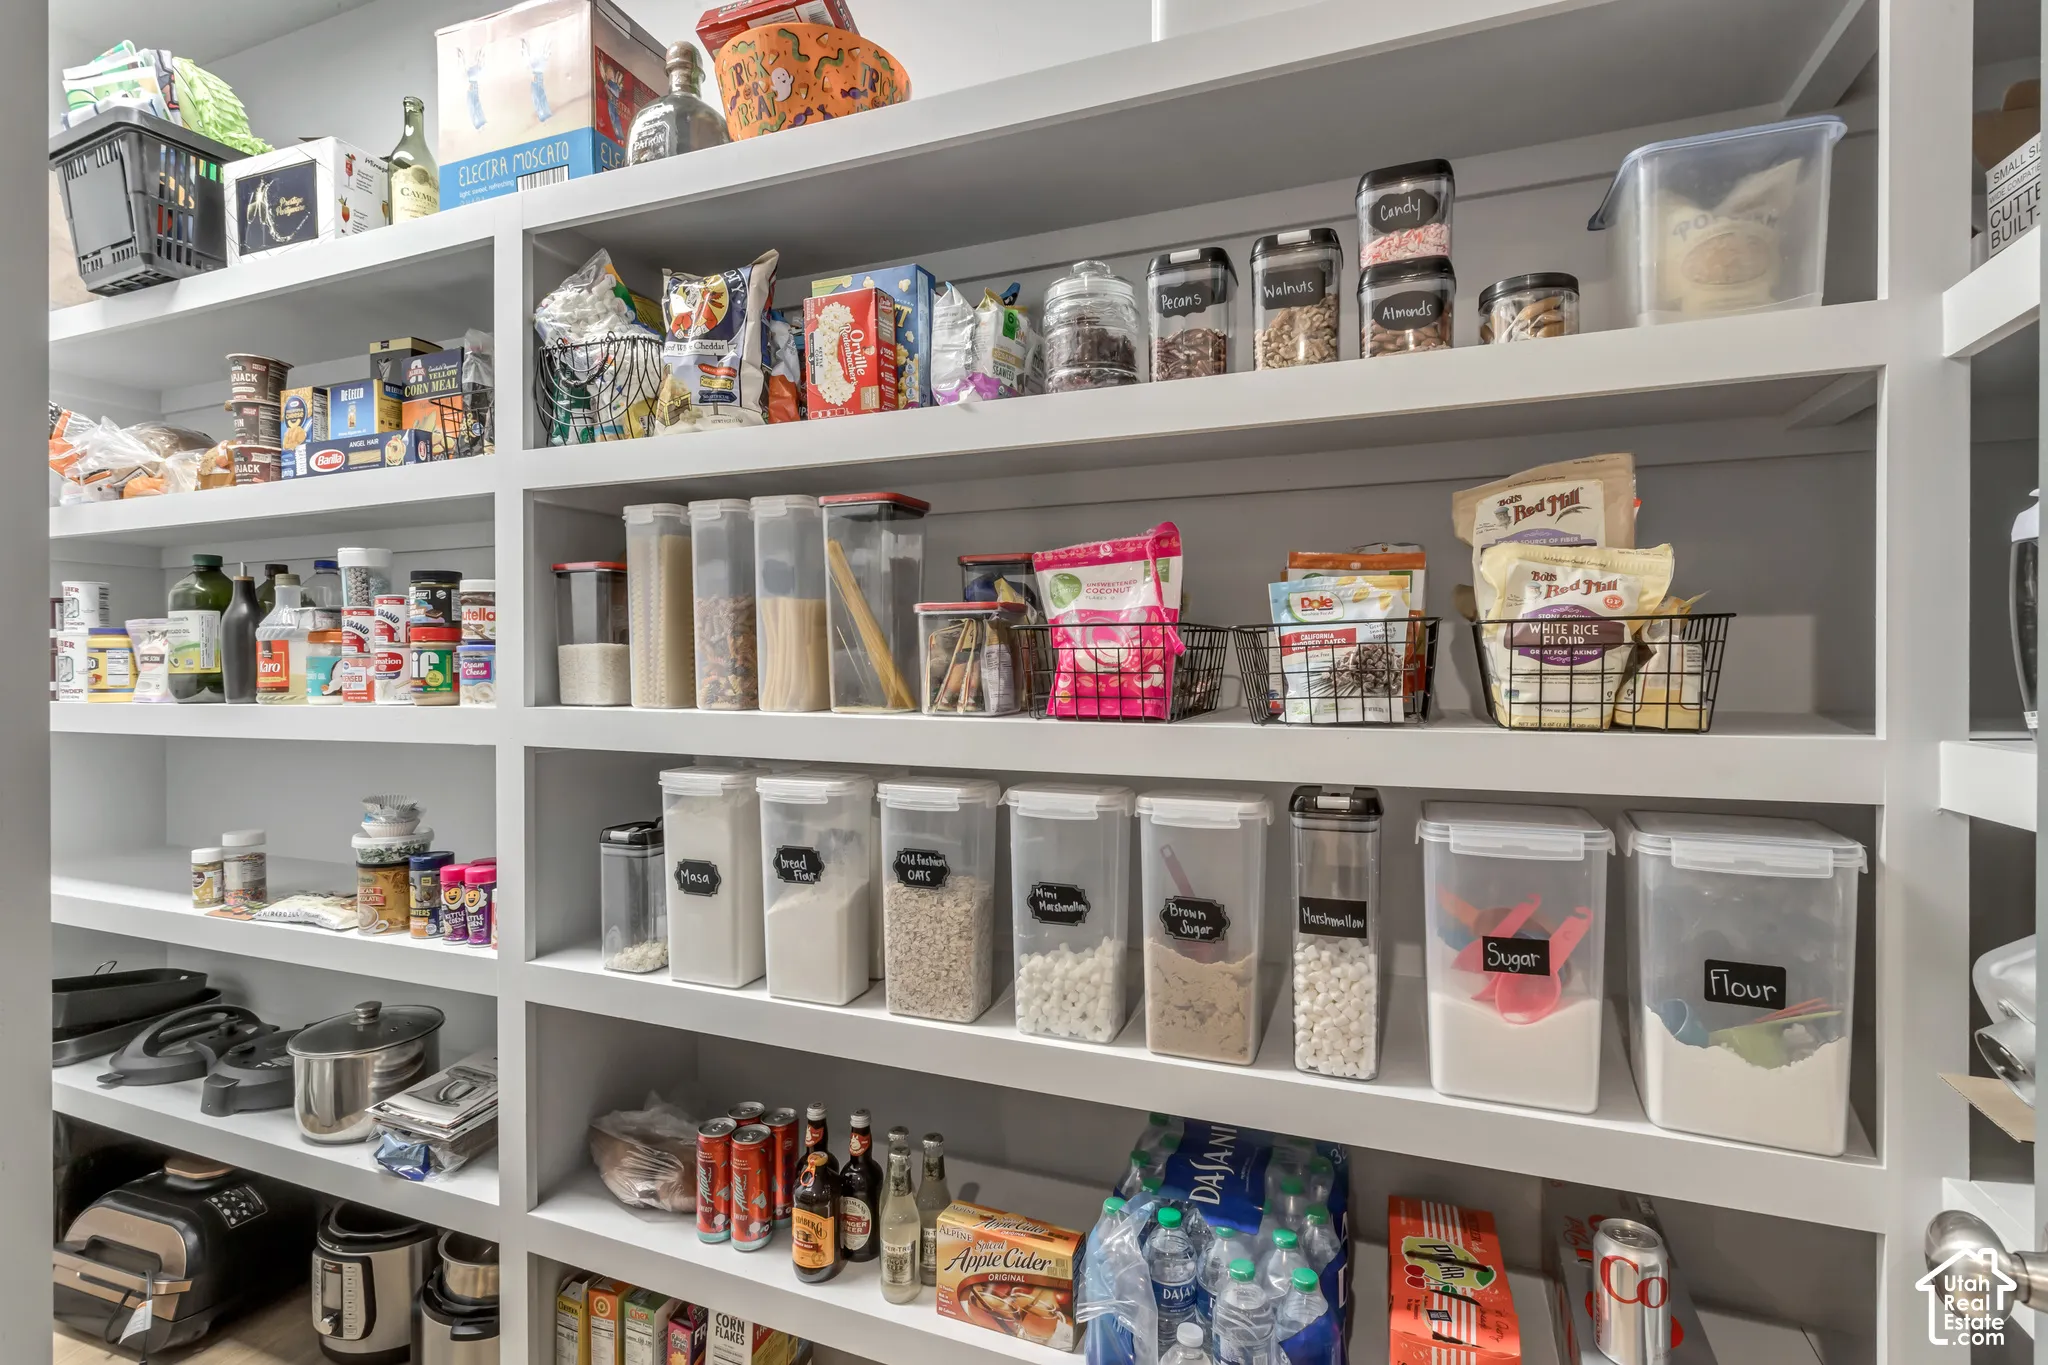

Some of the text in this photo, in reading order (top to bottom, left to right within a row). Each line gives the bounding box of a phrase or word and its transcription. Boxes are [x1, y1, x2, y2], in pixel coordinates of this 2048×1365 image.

[728, 51, 771, 91] TRICK
[737, 92, 778, 129] TREAT
[459, 141, 569, 187] ELECTRA MOSCATO
[1993, 154, 2026, 185] SMALL
[1380, 197, 1421, 221] Candy
[1264, 280, 1314, 299] Walnuts
[1161, 292, 1202, 311] Pecans
[1008, 313, 1015, 324] 6
[1382, 303, 1433, 320] Almonds
[694, 341, 725, 351] Cheddar
[851, 329, 868, 376] Orville
[840, 323, 858, 386] Redenbacher's
[428, 369, 458, 380] YELLOW
[404, 383, 430, 398] CORN
[431, 377, 458, 393] MEAL
[349, 438, 380, 448] ANGEL HAIR
[317, 454, 343, 466] Barilla
[1513, 497, 1545, 526] Red
[1546, 487, 1581, 517] Mill
[1085, 586, 1132, 595] COCONUT
[1087, 580, 1138, 588] UNSWEETENED
[1531, 570, 1618, 600] Bob's Red Mill
[1301, 596, 1334, 610] Dole
[346, 620, 370, 635] BRAND
[1529, 624, 1599, 636] WHITE RICE
[1301, 632, 1334, 641] CALIFORNIA
[260, 661, 280, 673] Karo
[463, 661, 485, 669] Cream
[780, 855, 807, 871] bread
[900, 854, 916, 866] Old
[680, 870, 710, 885] Masa
[794, 870, 817, 883] Flour
[907, 869, 931, 882] OATS
[1035, 887, 1058, 900] Mini
[445, 910, 465, 919] KETTLE
[1168, 903, 1207, 921] Brown
[1302, 908, 1364, 929] Marshmallow
[1180, 919, 1213, 939] Sugar
[1487, 942, 1541, 972] Sugar
[1710, 968, 1777, 1002] Flour
[1188, 1126, 1238, 1206] DASANI
[950, 1205, 976, 1216] ALPINE
[972, 1214, 1048, 1234] Apple Cider
[939, 1224, 973, 1242] ALPINE
[975, 1240, 1006, 1252] Spiced
[944, 1247, 1002, 1273] Apple
[1003, 1248, 1052, 1271] Cider
[988, 1273, 1026, 1283] ORIGINAL
[629, 1308, 649, 1320] Chex
[716, 1312, 745, 1335] CORN
[715, 1325, 745, 1346] FLAKES
